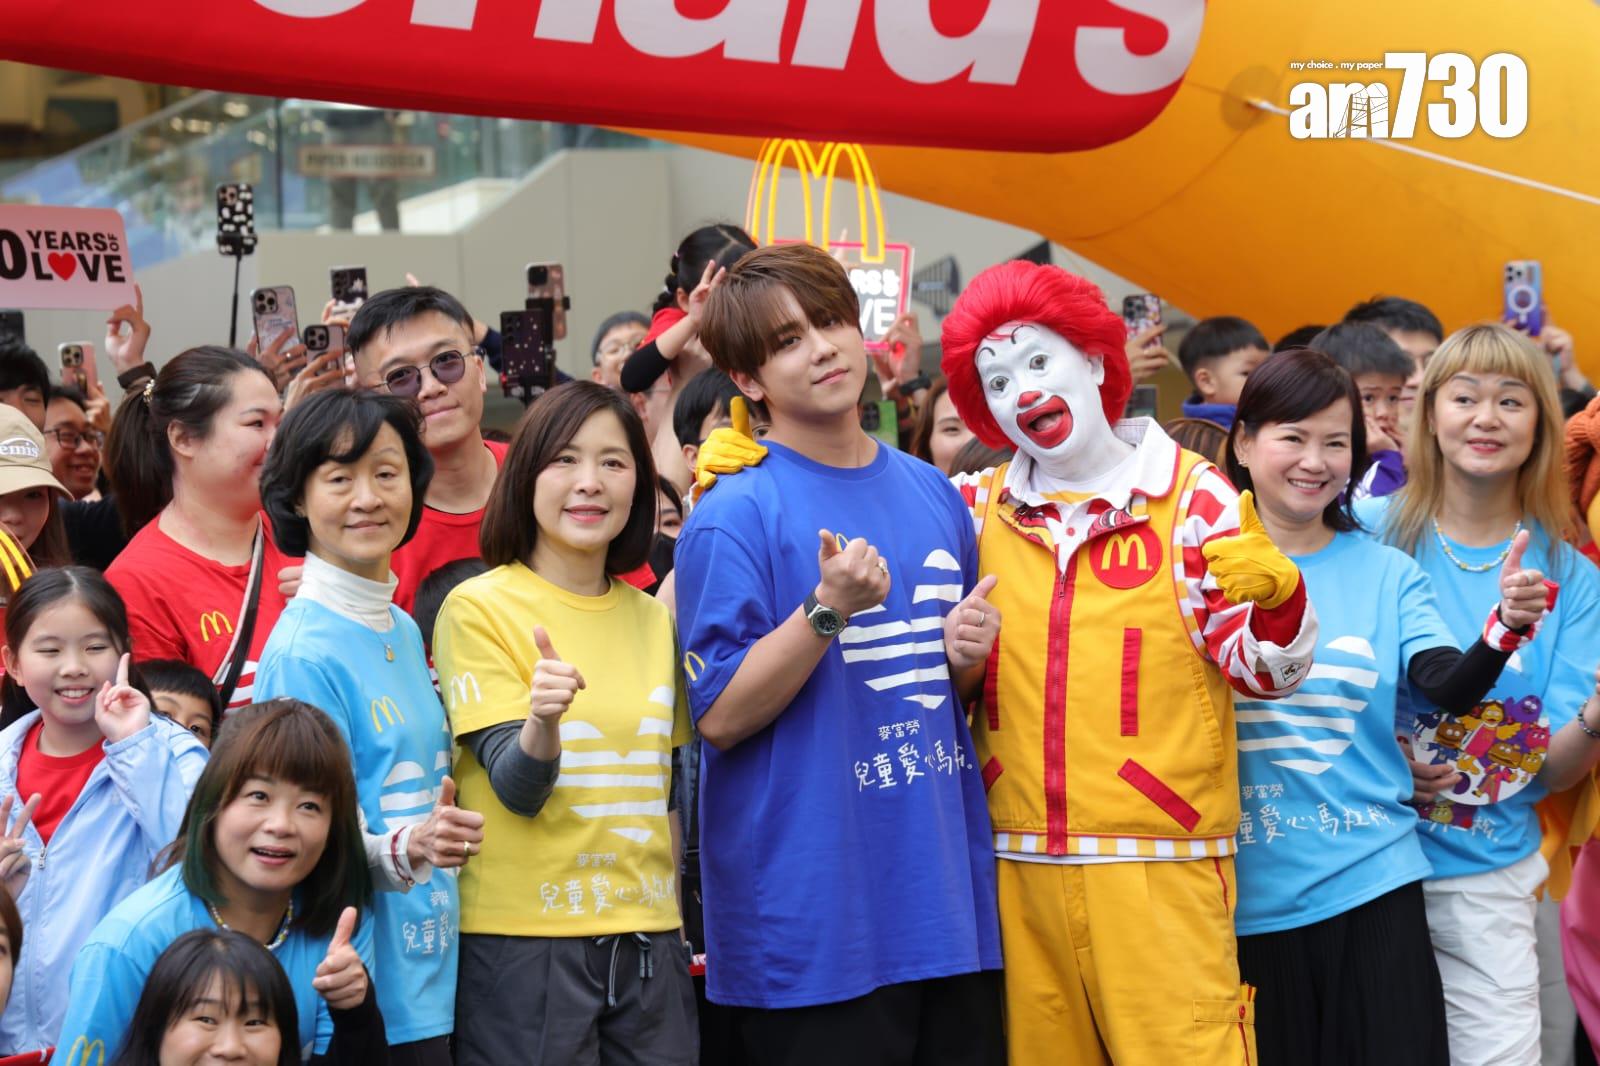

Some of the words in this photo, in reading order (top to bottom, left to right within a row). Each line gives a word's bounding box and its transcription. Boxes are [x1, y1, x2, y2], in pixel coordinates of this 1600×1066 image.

[26, 229, 108, 252] YEARS
[107, 233, 119, 252] OF
[877, 719, 920, 741] 麥當勞
